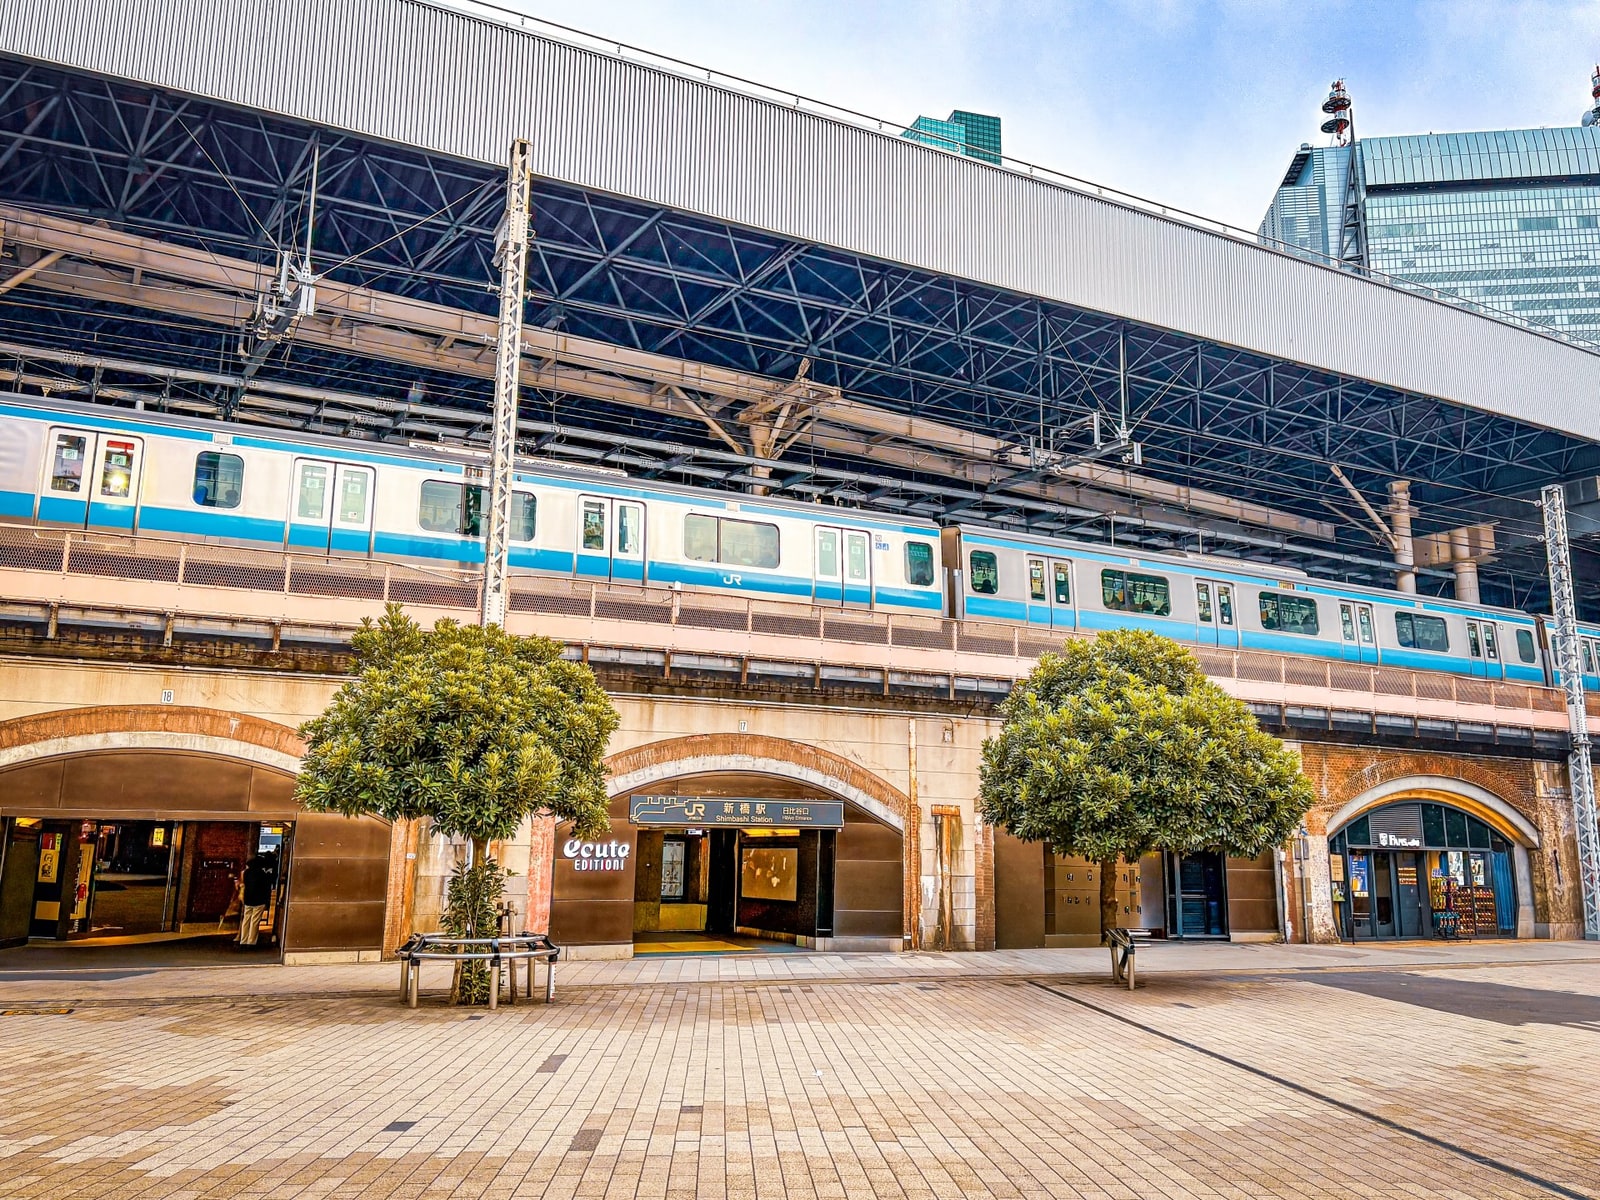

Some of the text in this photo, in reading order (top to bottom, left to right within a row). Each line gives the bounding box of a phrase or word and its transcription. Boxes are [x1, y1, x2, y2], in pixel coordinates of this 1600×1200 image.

[723, 574, 742, 586] JR
[163, 690, 172, 702] 18
[684, 804, 706, 816] JR
[723, 802, 766, 815] 新橋駅
[782, 807, 809, 815] 日比谷口
